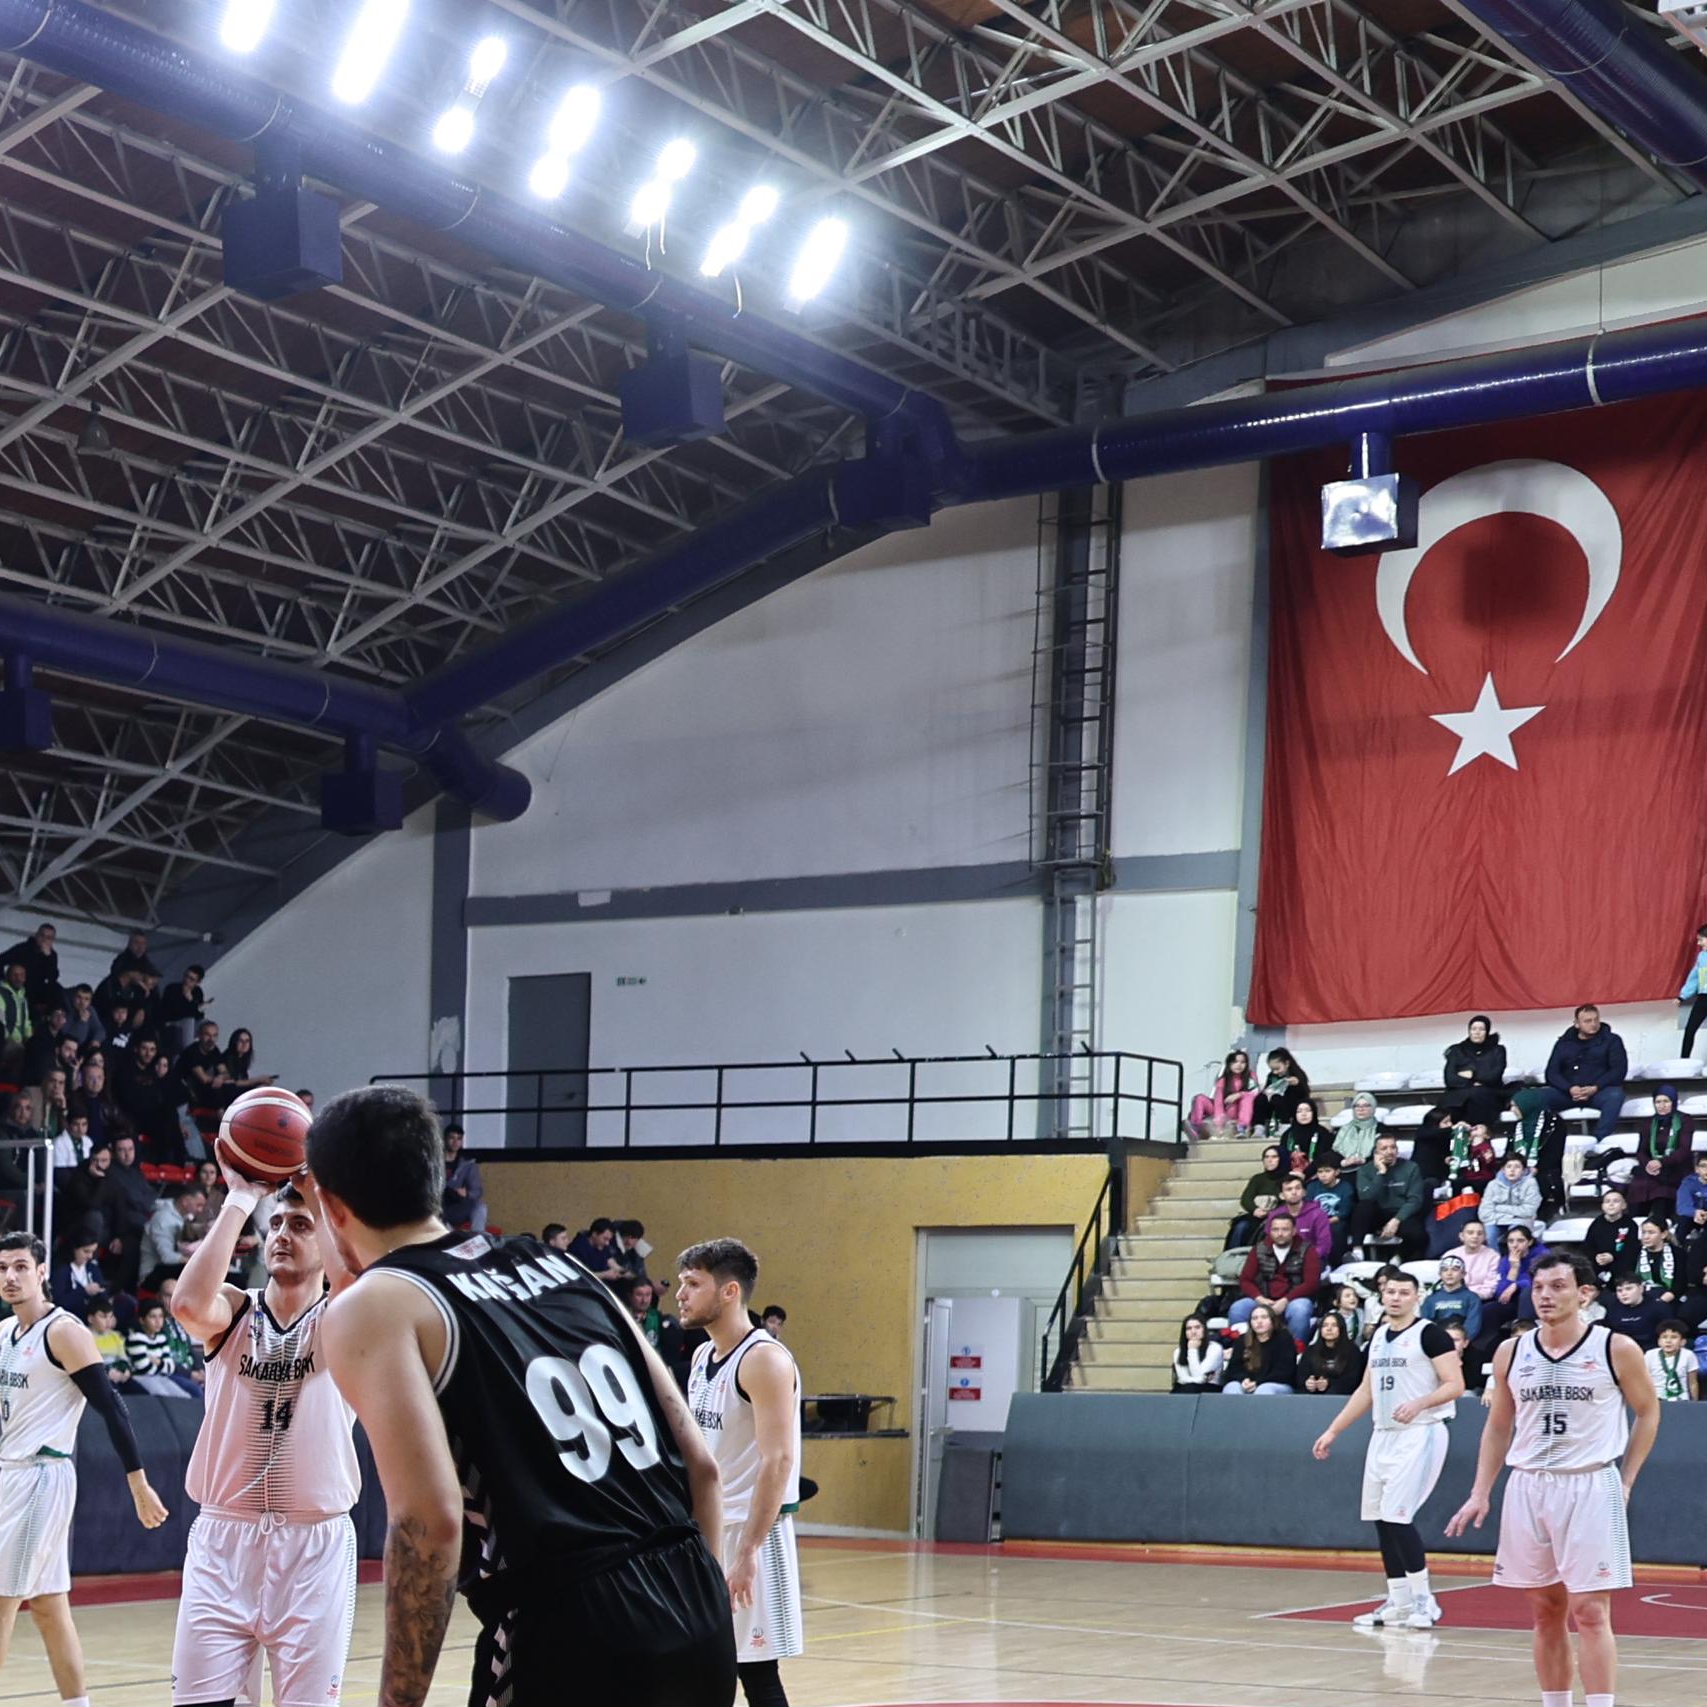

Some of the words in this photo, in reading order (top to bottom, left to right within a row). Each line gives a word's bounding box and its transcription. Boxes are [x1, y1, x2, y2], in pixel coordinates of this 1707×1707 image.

[445, 1253, 581, 1301] KAĞAN
[238, 1353, 292, 1381] SAKARYA
[1380, 1375, 1395, 1391] 19
[1565, 1386, 1595, 1401] BBSK
[259, 1398, 294, 1431] 14
[525, 1344, 661, 1483] 99
[1542, 1412, 1567, 1435] 15
